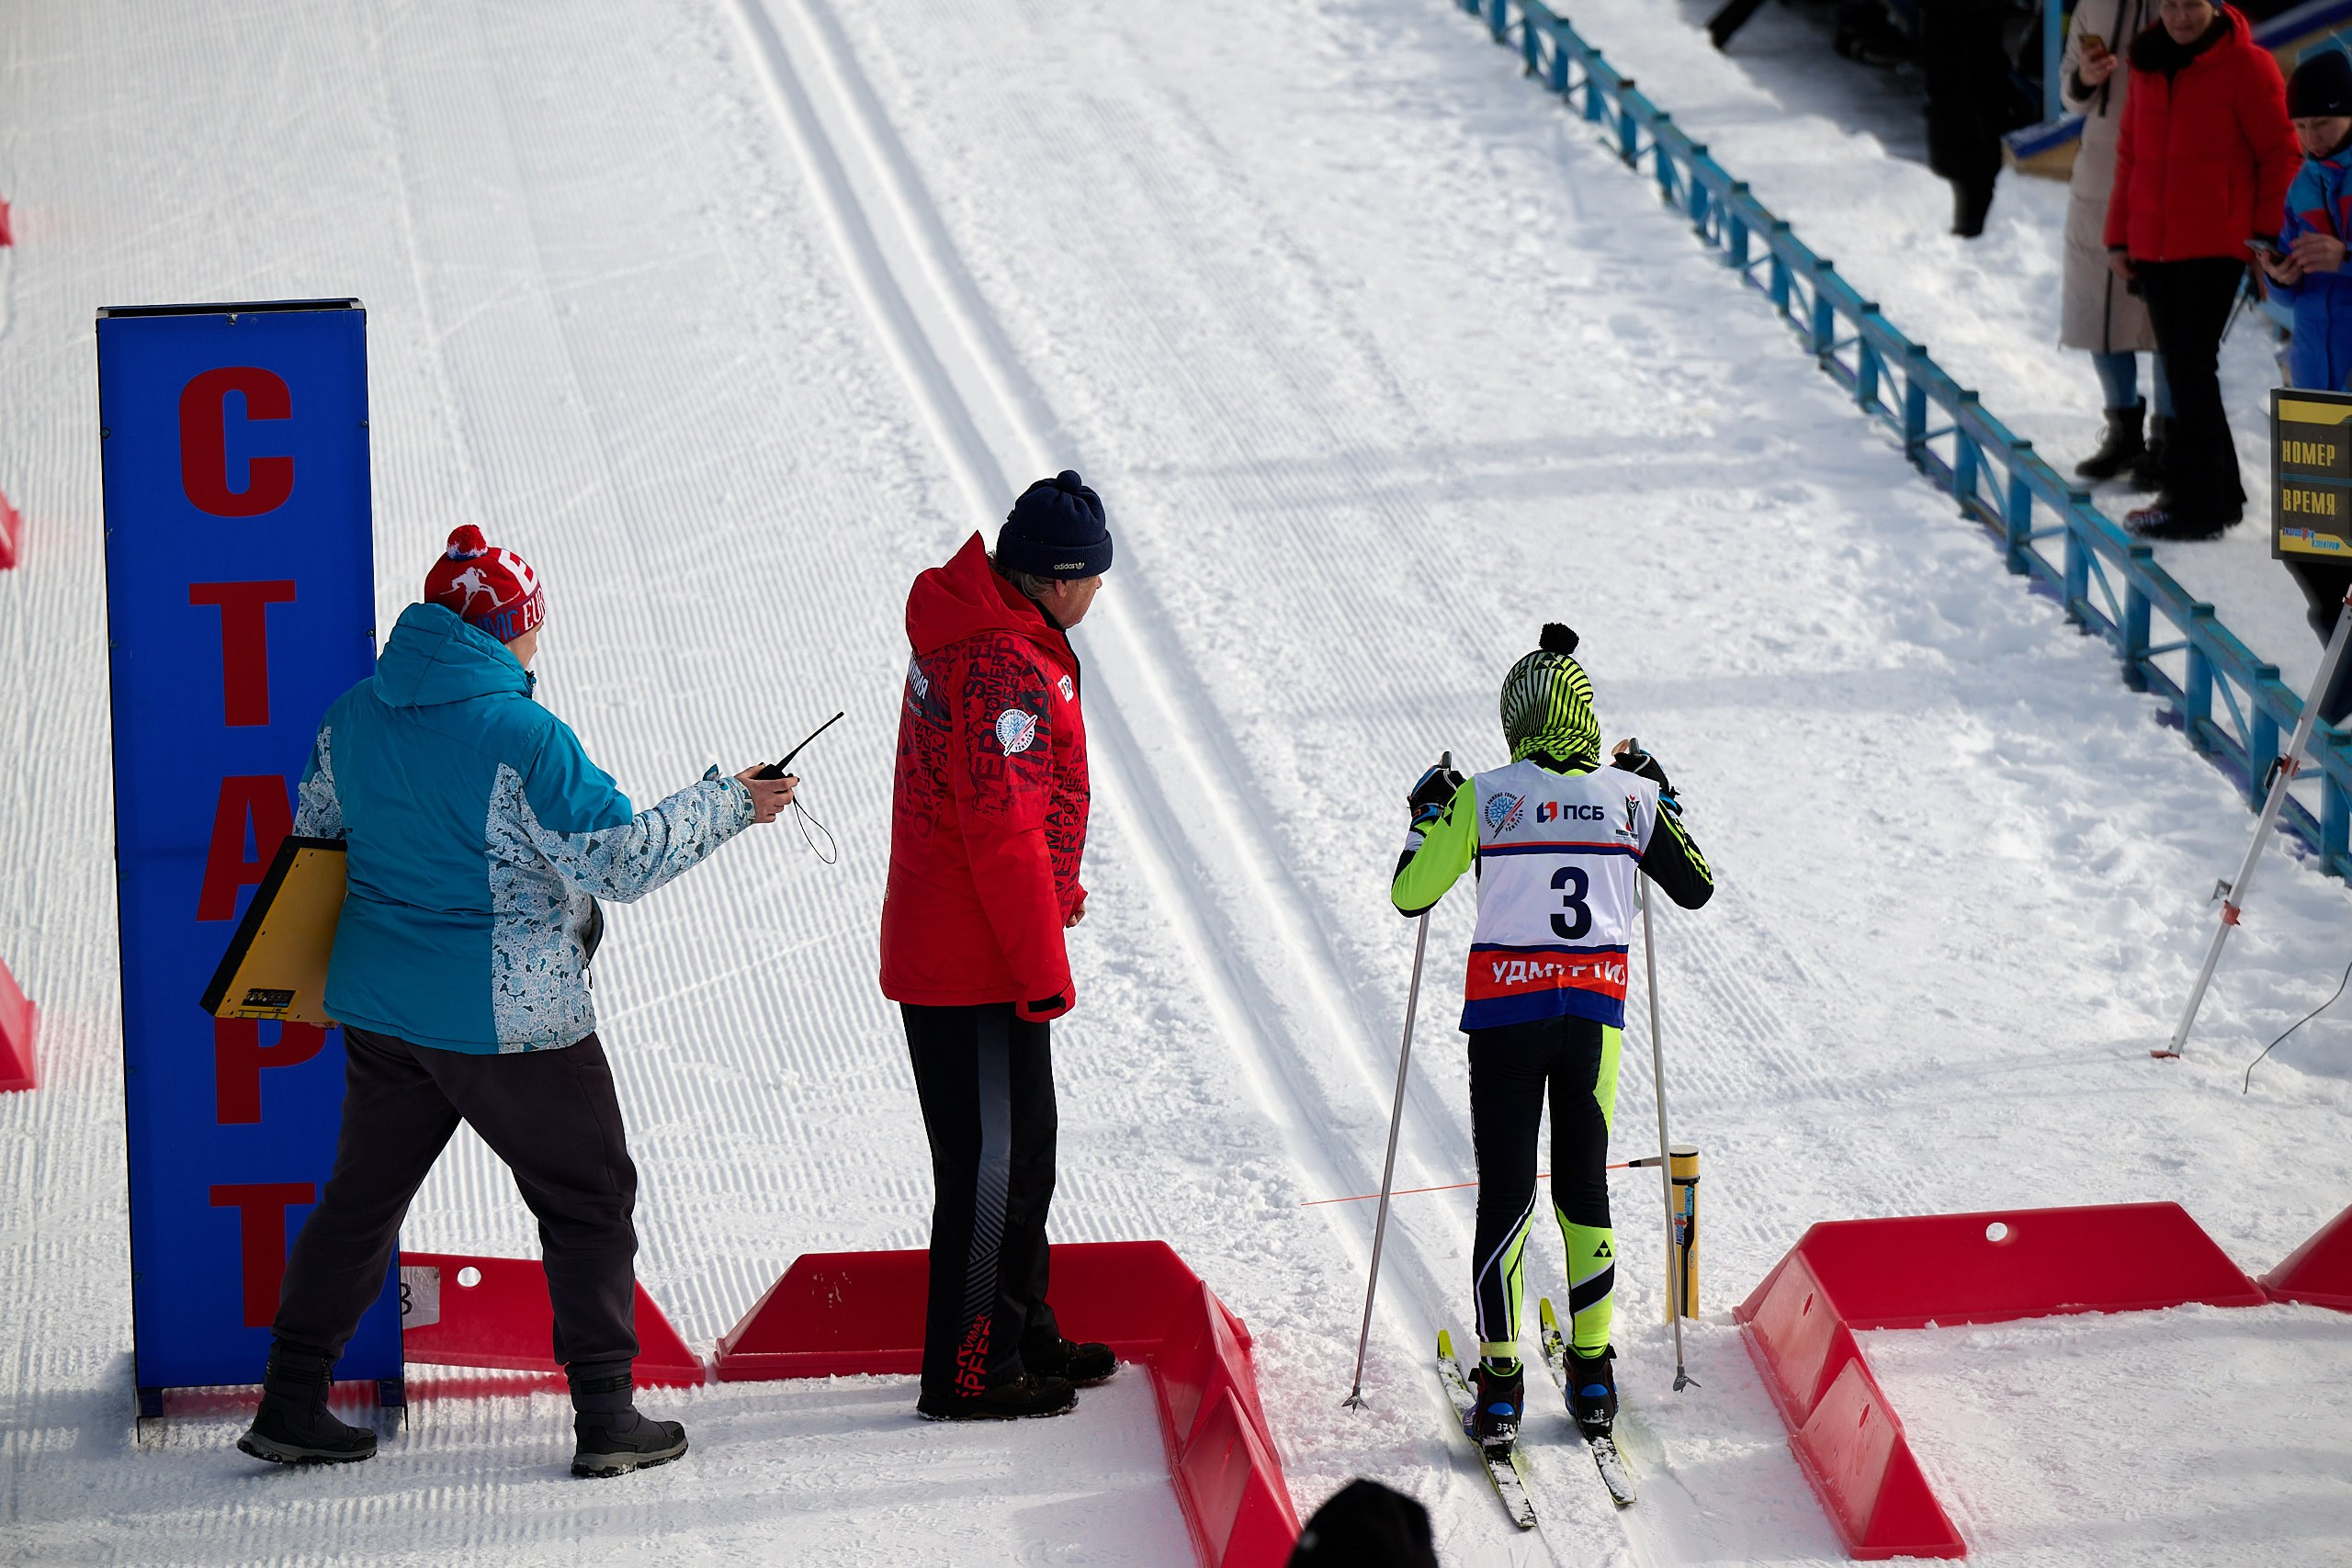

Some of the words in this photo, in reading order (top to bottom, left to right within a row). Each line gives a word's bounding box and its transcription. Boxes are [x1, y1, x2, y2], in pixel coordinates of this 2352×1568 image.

[2282, 440, 2335, 467] НОМЕР
[2282, 489, 2335, 515] ВРЕМЯ
[1054, 562, 1075, 570] adidas
[1564, 805, 1605, 821] ПСБ
[1550, 866, 1592, 940] 3
[964, 1314, 987, 1349] VMAX
